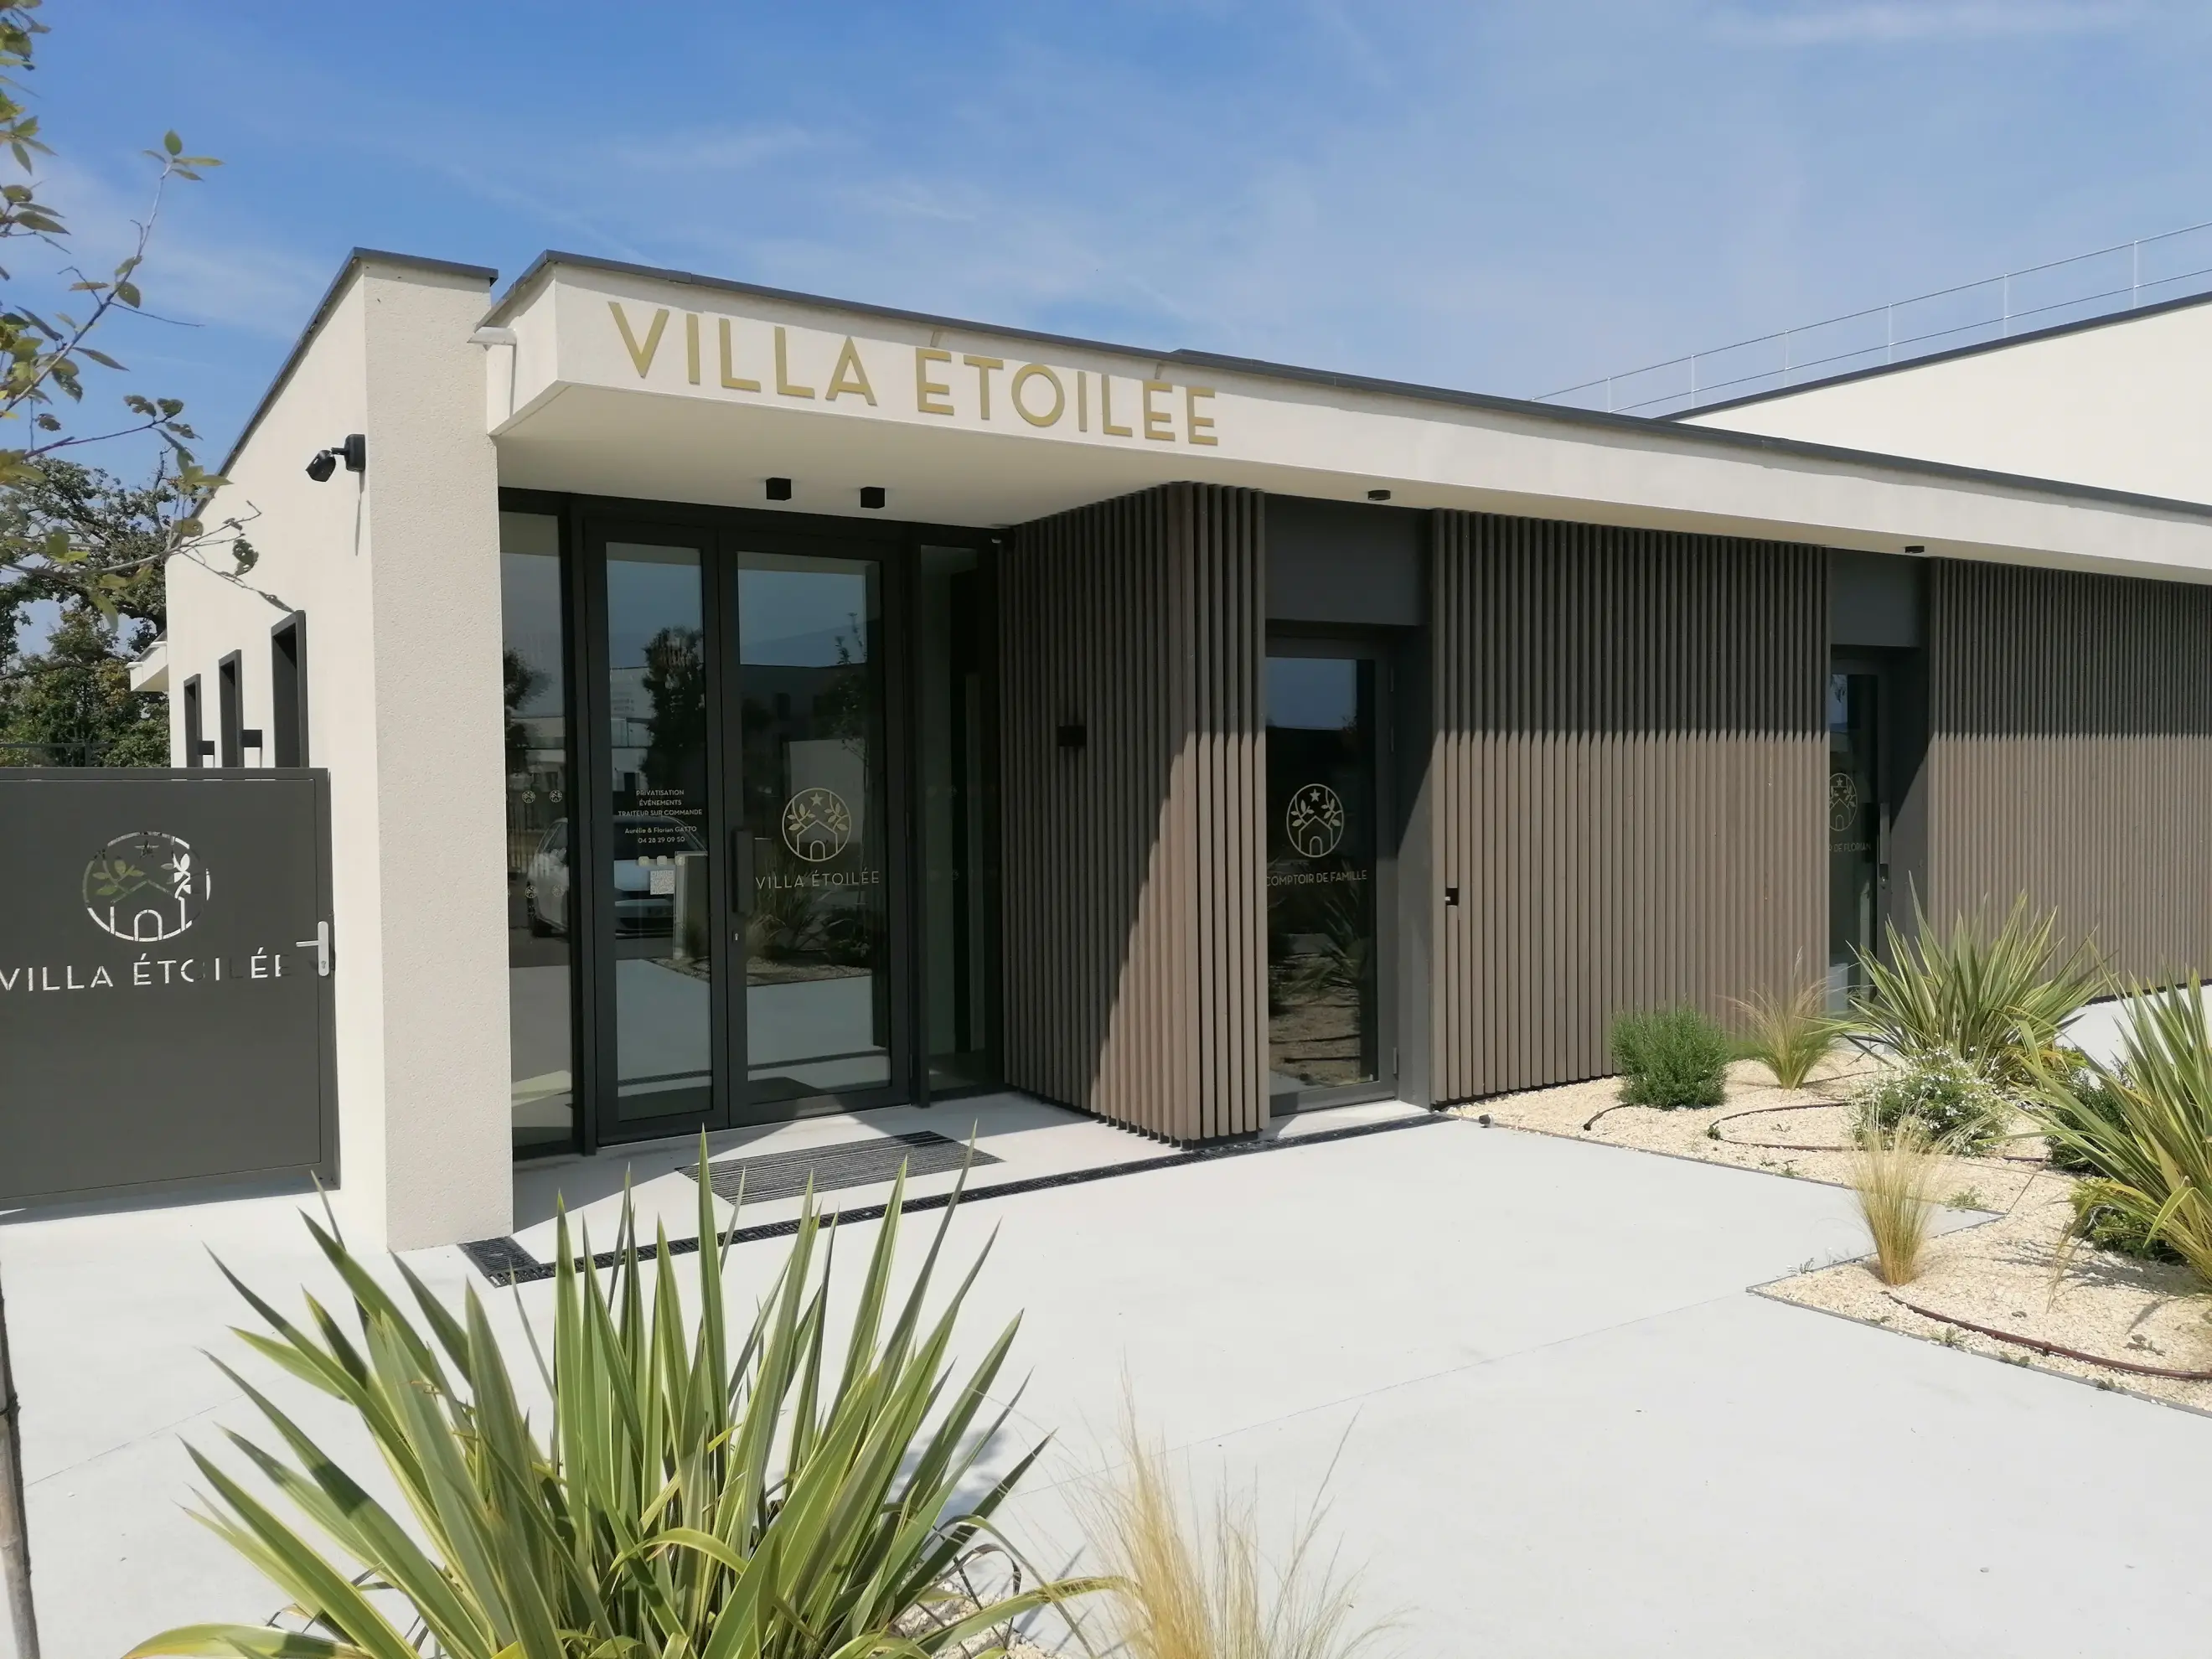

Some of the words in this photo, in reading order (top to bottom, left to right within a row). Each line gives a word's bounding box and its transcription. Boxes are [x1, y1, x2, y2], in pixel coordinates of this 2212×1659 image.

[607, 301, 877, 406] VILLA
[914, 330, 1218, 446] ÉTOILÉE
[1833, 843, 1843, 852] DE
[755, 874, 804, 890] VILLA
[812, 866, 880, 886] ÉTOILÉE
[1266, 873, 1315, 886] COMPTOIR
[1316, 872, 1329, 882] DE
[1331, 870, 1367, 881] FAMILLE
[0, 964, 114, 992] VILLA
